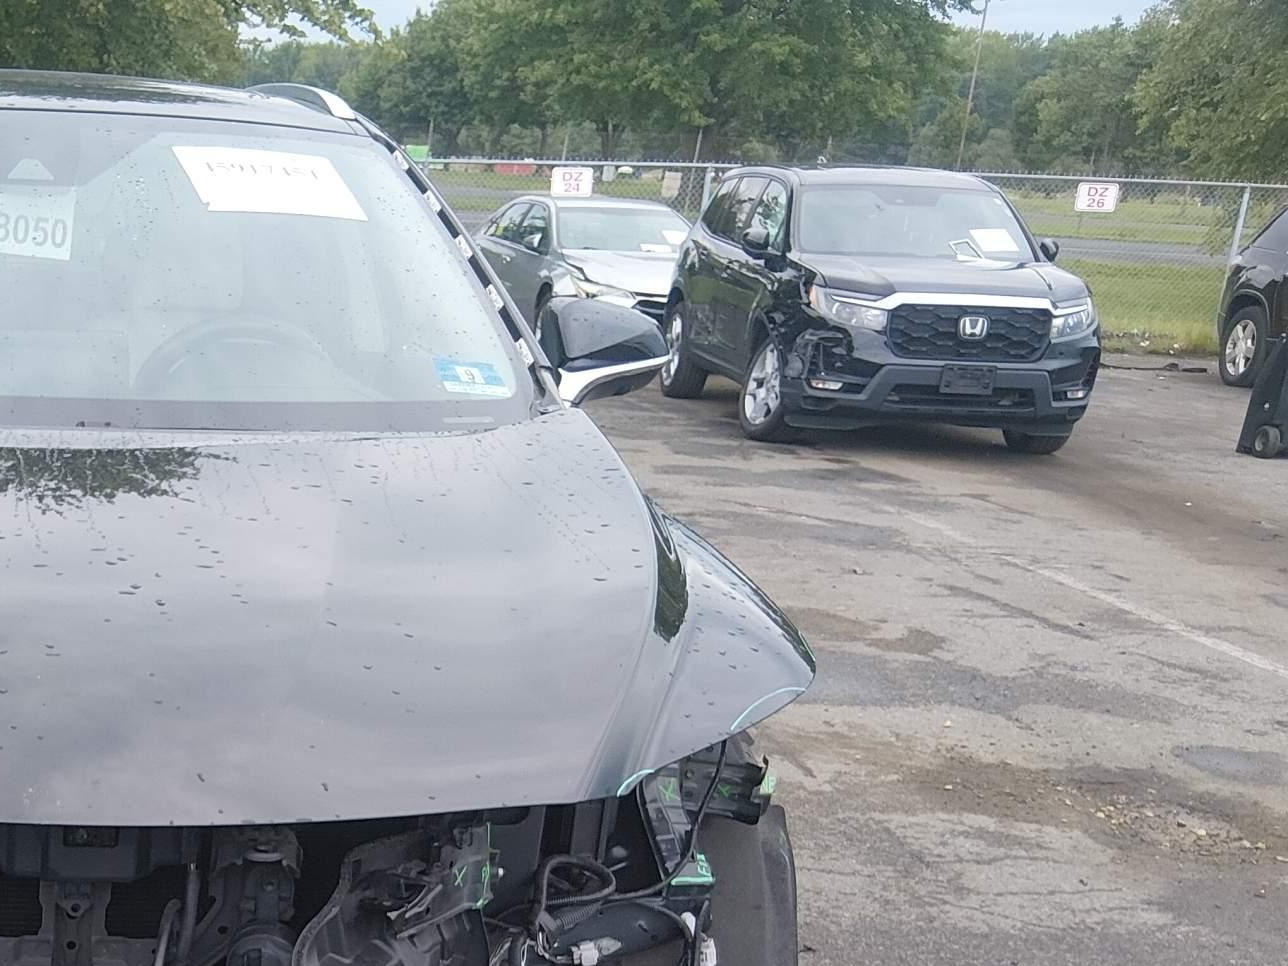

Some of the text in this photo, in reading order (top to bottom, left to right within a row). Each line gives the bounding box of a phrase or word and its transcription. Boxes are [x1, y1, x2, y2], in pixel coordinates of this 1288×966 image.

[562, 171, 583, 182] DZ
[564, 182, 580, 193] 24
[1087, 186, 1109, 197] DZ
[1086, 197, 1105, 208] 26
